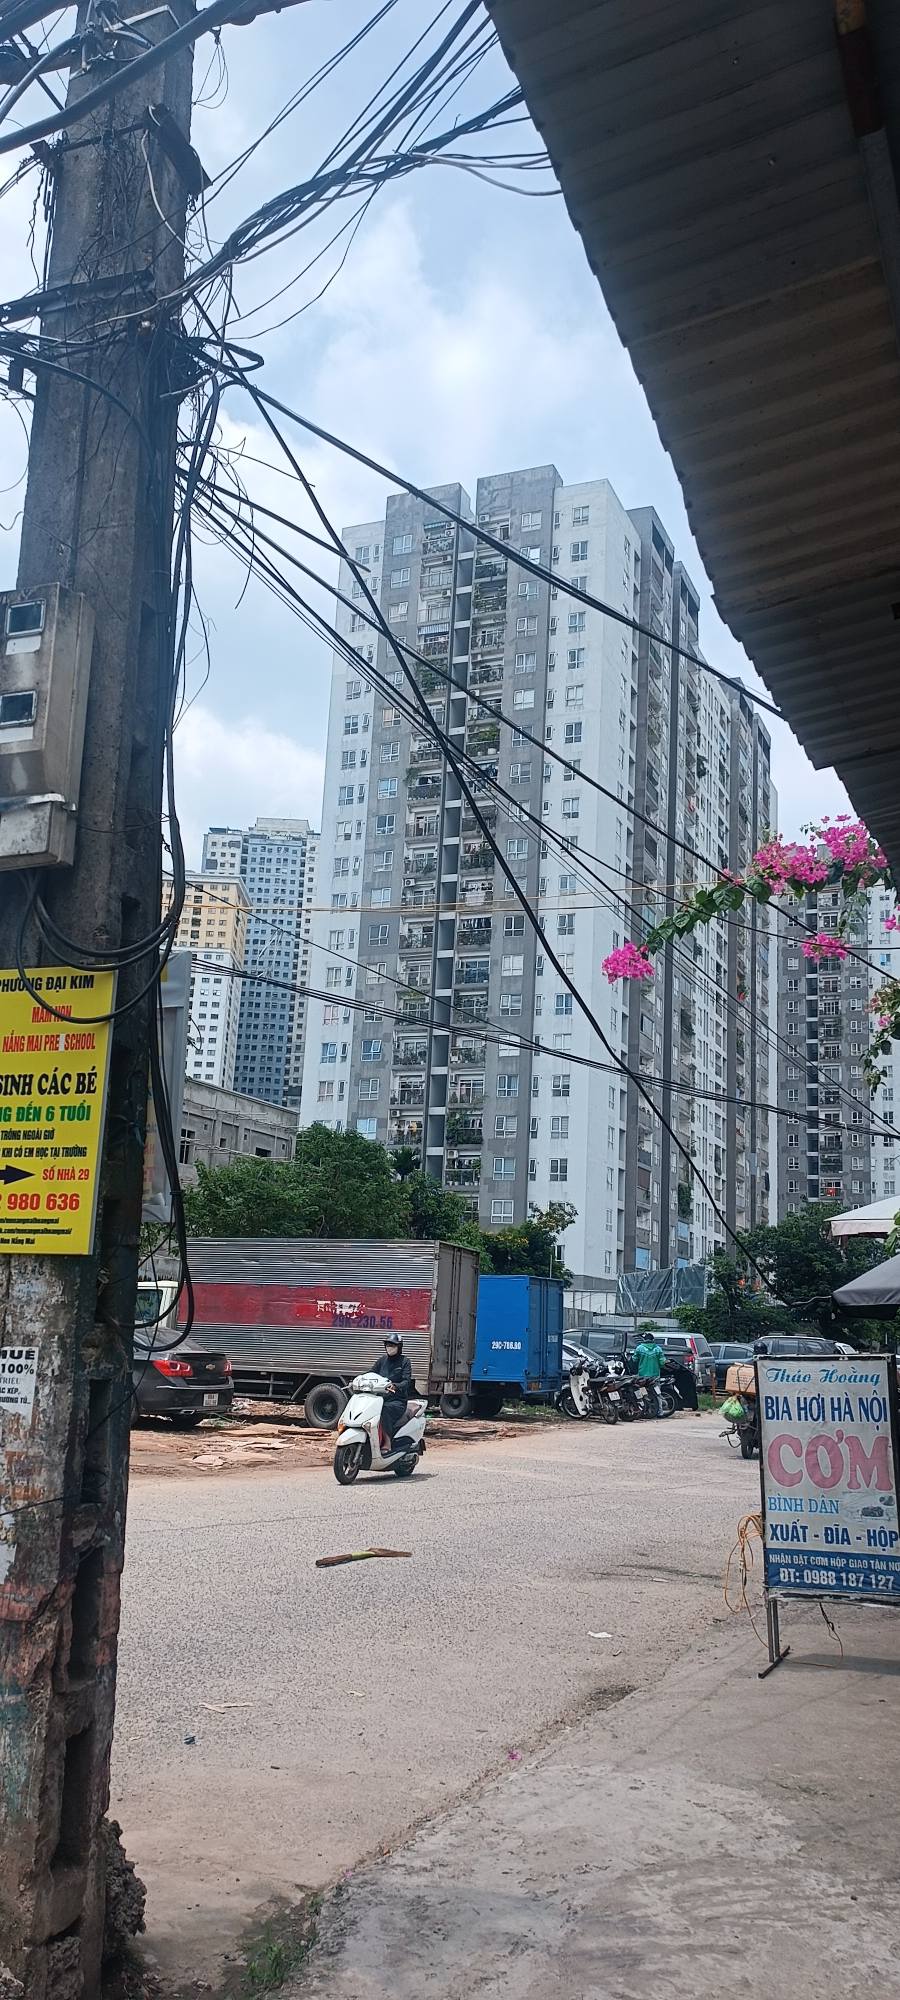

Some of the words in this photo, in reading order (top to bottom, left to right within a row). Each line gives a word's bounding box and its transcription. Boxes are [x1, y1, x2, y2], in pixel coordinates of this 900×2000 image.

[0, 977, 42, 992] HƯNG
[46, 976, 66, 992] ĐẠI
[70, 975, 95, 989] KIM
[26, 1034, 42, 1052] MAI
[44, 1034, 60, 1051] PRE
[64, 1033, 95, 1050] SCHOOL
[37, 1066, 72, 1095] CÁC
[75, 1065, 97, 1094] BÉ
[0, 1106, 12, 1122] G
[15, 1100, 42, 1122] ĐẾN
[45, 1105, 55, 1121] 6
[59, 1099, 91, 1121] TUỔI
[50, 1146, 60, 1160] TẠI
[42, 1165, 56, 1180] SỐ
[57, 1166, 76, 1180] NHÀ
[78, 1168, 90, 1180] 29
[7, 1192, 41, 1211] 980
[45, 1192, 80, 1211] 636
[1, 1363, 35, 1375] 100%
[764, 1395, 793, 1421] BIA
[796, 1393, 825, 1422] HƠI
[830, 1391, 855, 1422] HÀ
[858, 1389, 888, 1431] NỘI
[767, 1429, 893, 1491] CƠM
[768, 1493, 804, 1513] BÌNH
[808, 1494, 840, 1514] DÂN
[770, 1518, 808, 1543] XUẤT
[824, 1523, 852, 1545] ĐĨA
[866, 1525, 899, 1551] HỘP
[769, 1552, 792, 1566] NHẬN
[793, 1553, 808, 1567] ĐẶT
[810, 1556, 828, 1567] CƠM
[849, 1559, 868, 1569] GIAO
[869, 1558, 887, 1572] TẬN
[780, 1567, 800, 1583] ĐT:
[803, 1569, 836, 1586] 0988
[840, 1572, 865, 1588] 187
[869, 1574, 895, 1591] 127
